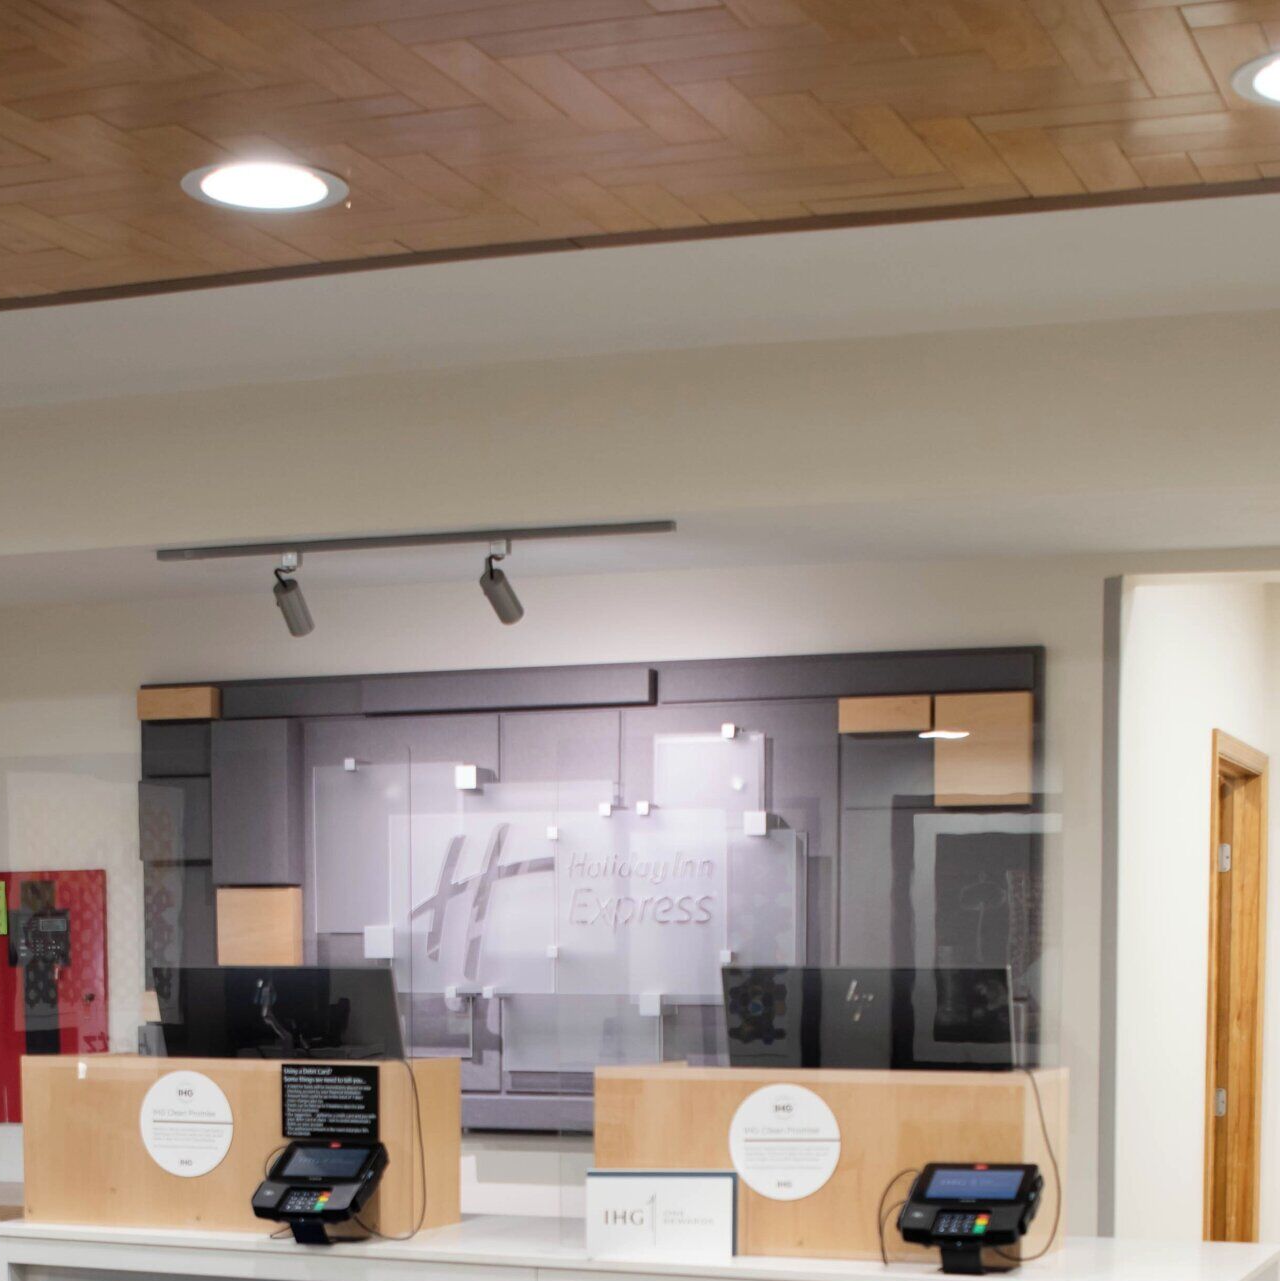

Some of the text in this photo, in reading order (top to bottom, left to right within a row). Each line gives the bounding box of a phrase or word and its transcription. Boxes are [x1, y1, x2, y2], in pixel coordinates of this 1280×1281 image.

[568, 851, 714, 885] Holiday Inn
[569, 887, 714, 933] Express
[602, 1209, 645, 1226] IHG
